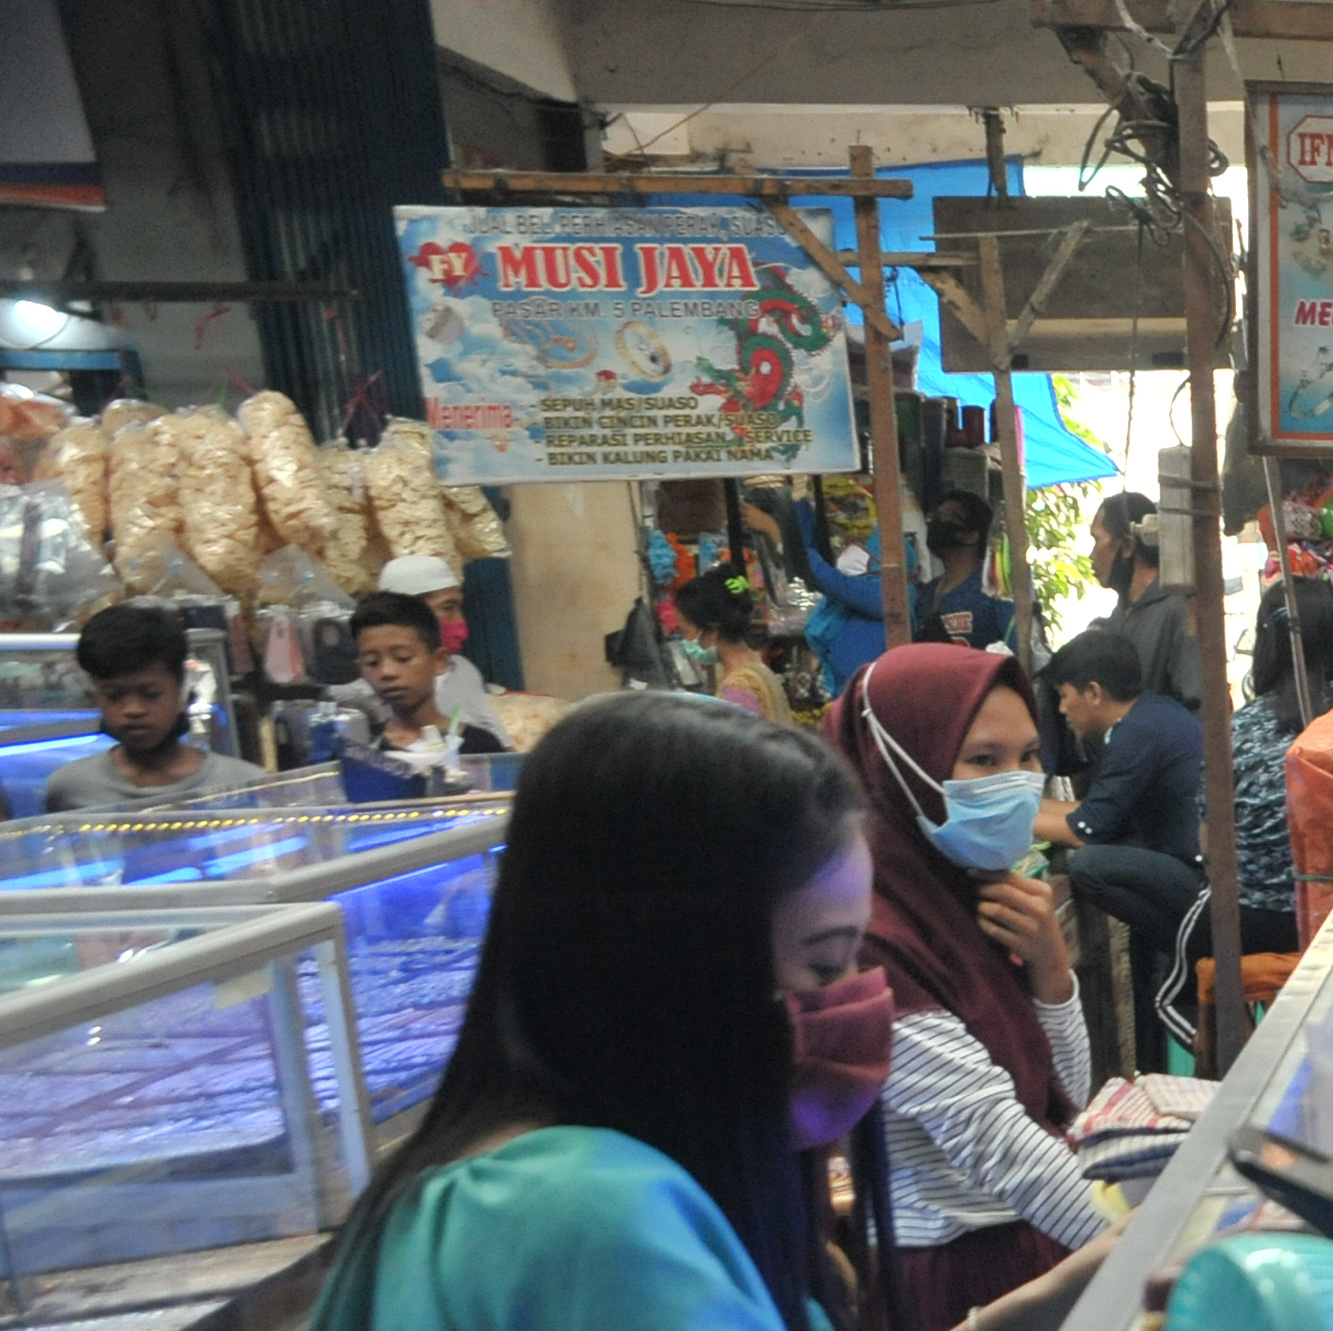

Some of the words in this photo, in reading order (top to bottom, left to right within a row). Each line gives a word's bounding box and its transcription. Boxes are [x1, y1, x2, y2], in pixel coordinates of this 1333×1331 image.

[467, 214, 512, 235] JUAL
[559, 213, 662, 236] PERHIASAN
[428, 251, 469, 281] FY
[496, 244, 625, 290] MUSI
[637, 244, 759, 296] JAYA
[492, 301, 562, 319] PASAR
[569, 301, 606, 319] KM.
[613, 301, 626, 319] 5
[631, 300, 761, 320] PALEMBANG
[541, 398, 596, 412] SEPUH
[543, 416, 592, 430] BIKIN
[600, 414, 658, 429] CINCIN
[546, 432, 628, 448] REPARASI
[633, 431, 726, 447] PERHIASAN
[746, 429, 813, 444] SERVICE
[547, 451, 598, 466] BIKIN
[602, 449, 668, 465] KALUNG
[673, 447, 722, 463] PAKAI
[727, 446, 774, 462] NAMA
